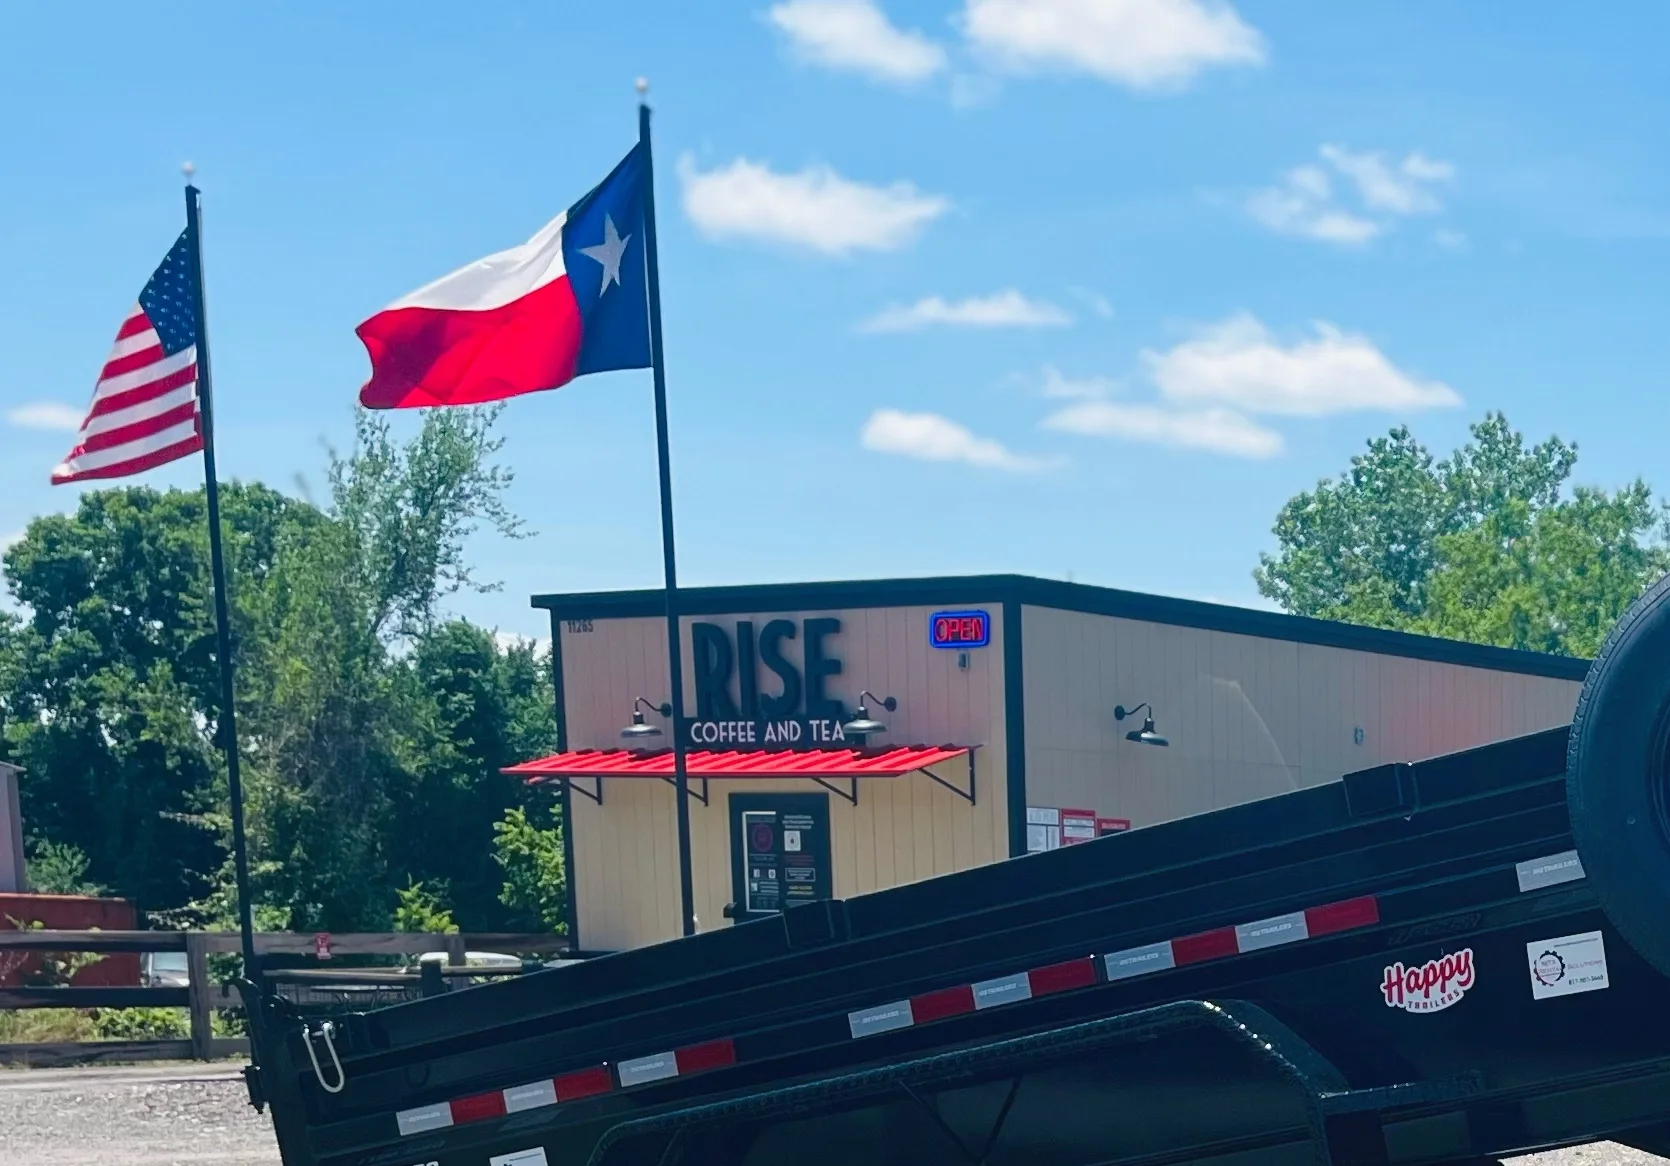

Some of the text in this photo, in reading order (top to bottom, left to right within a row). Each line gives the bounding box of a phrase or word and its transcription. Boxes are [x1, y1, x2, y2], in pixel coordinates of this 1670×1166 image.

[935, 617, 983, 642] OPEN
[692, 617, 843, 716] RISE
[690, 719, 845, 743] COFFEE AND TEA
[1383, 951, 1471, 1004] Happy
[1408, 989, 1460, 1009] TRAILERS
